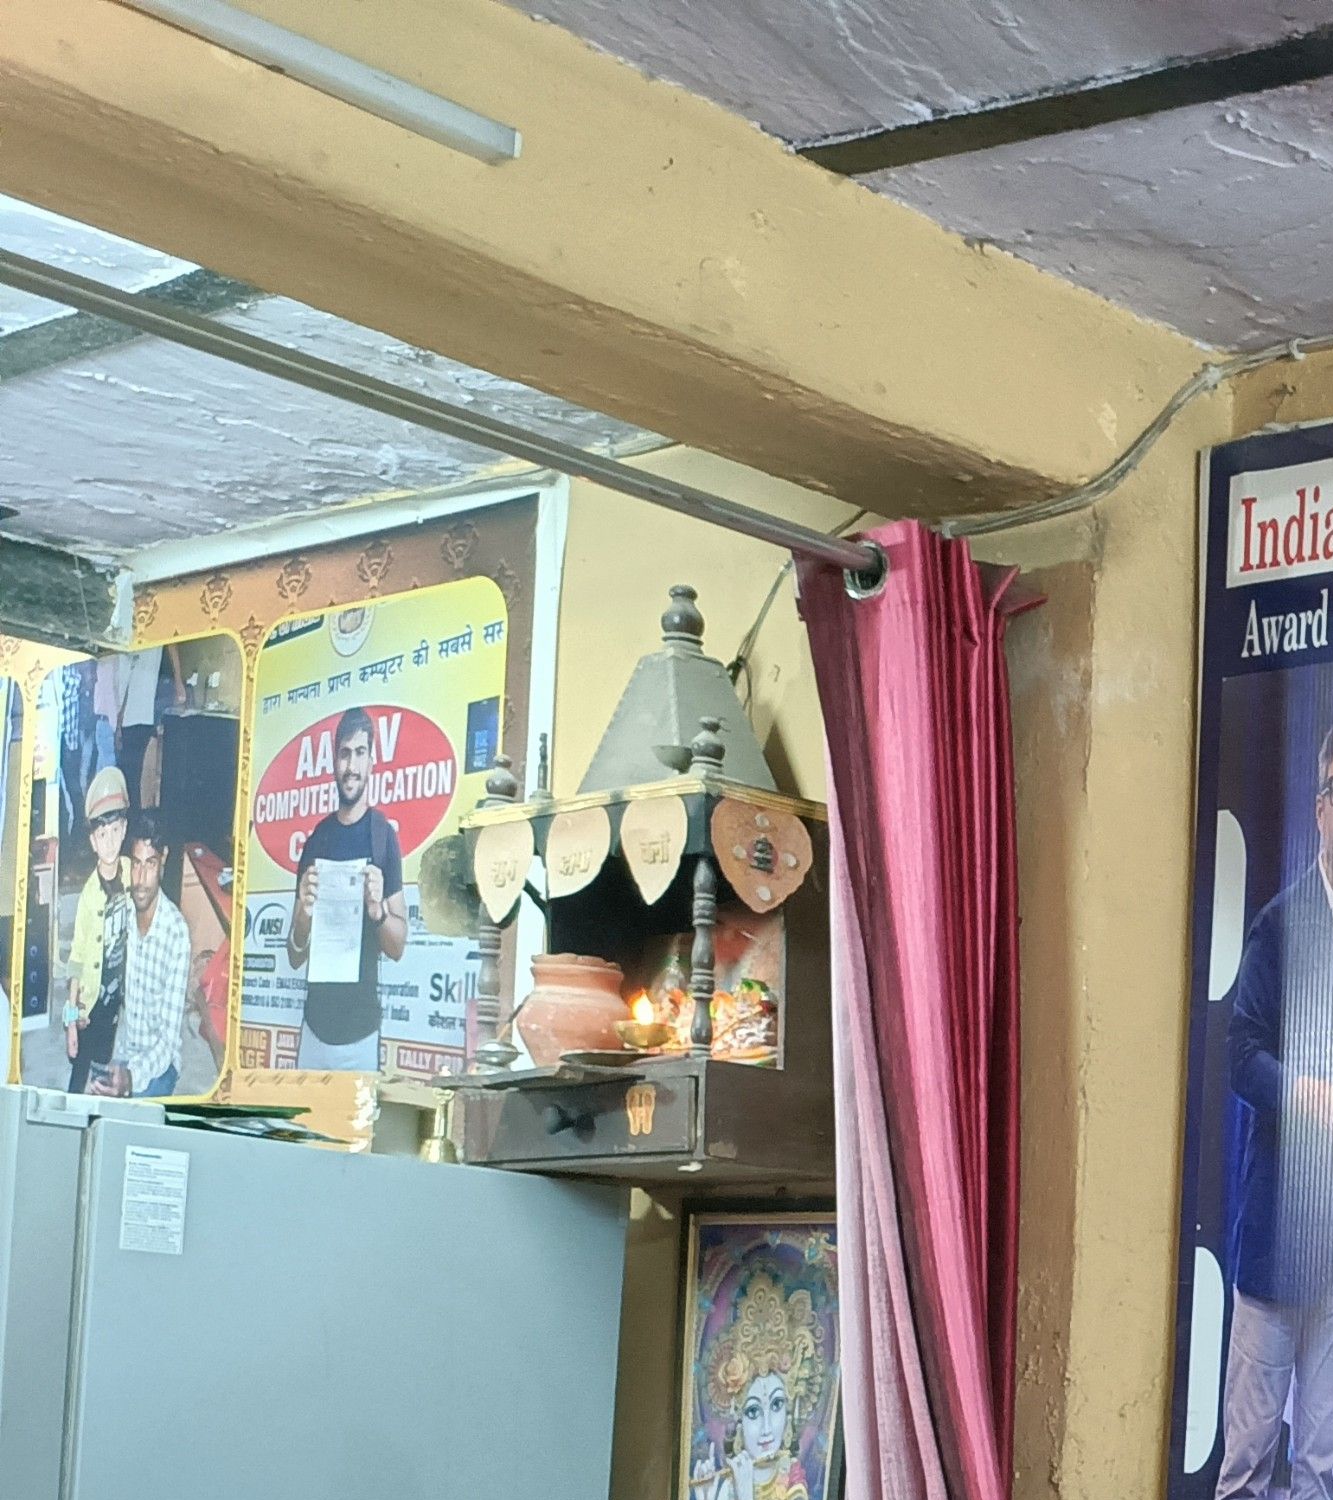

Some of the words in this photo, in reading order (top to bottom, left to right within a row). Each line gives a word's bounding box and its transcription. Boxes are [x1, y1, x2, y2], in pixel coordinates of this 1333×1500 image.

[1240, 597, 1329, 658] Award
[296, 712, 402, 781] AAV
[256, 779, 340, 823] COMPUTER
[368, 759, 453, 807] UCATION
